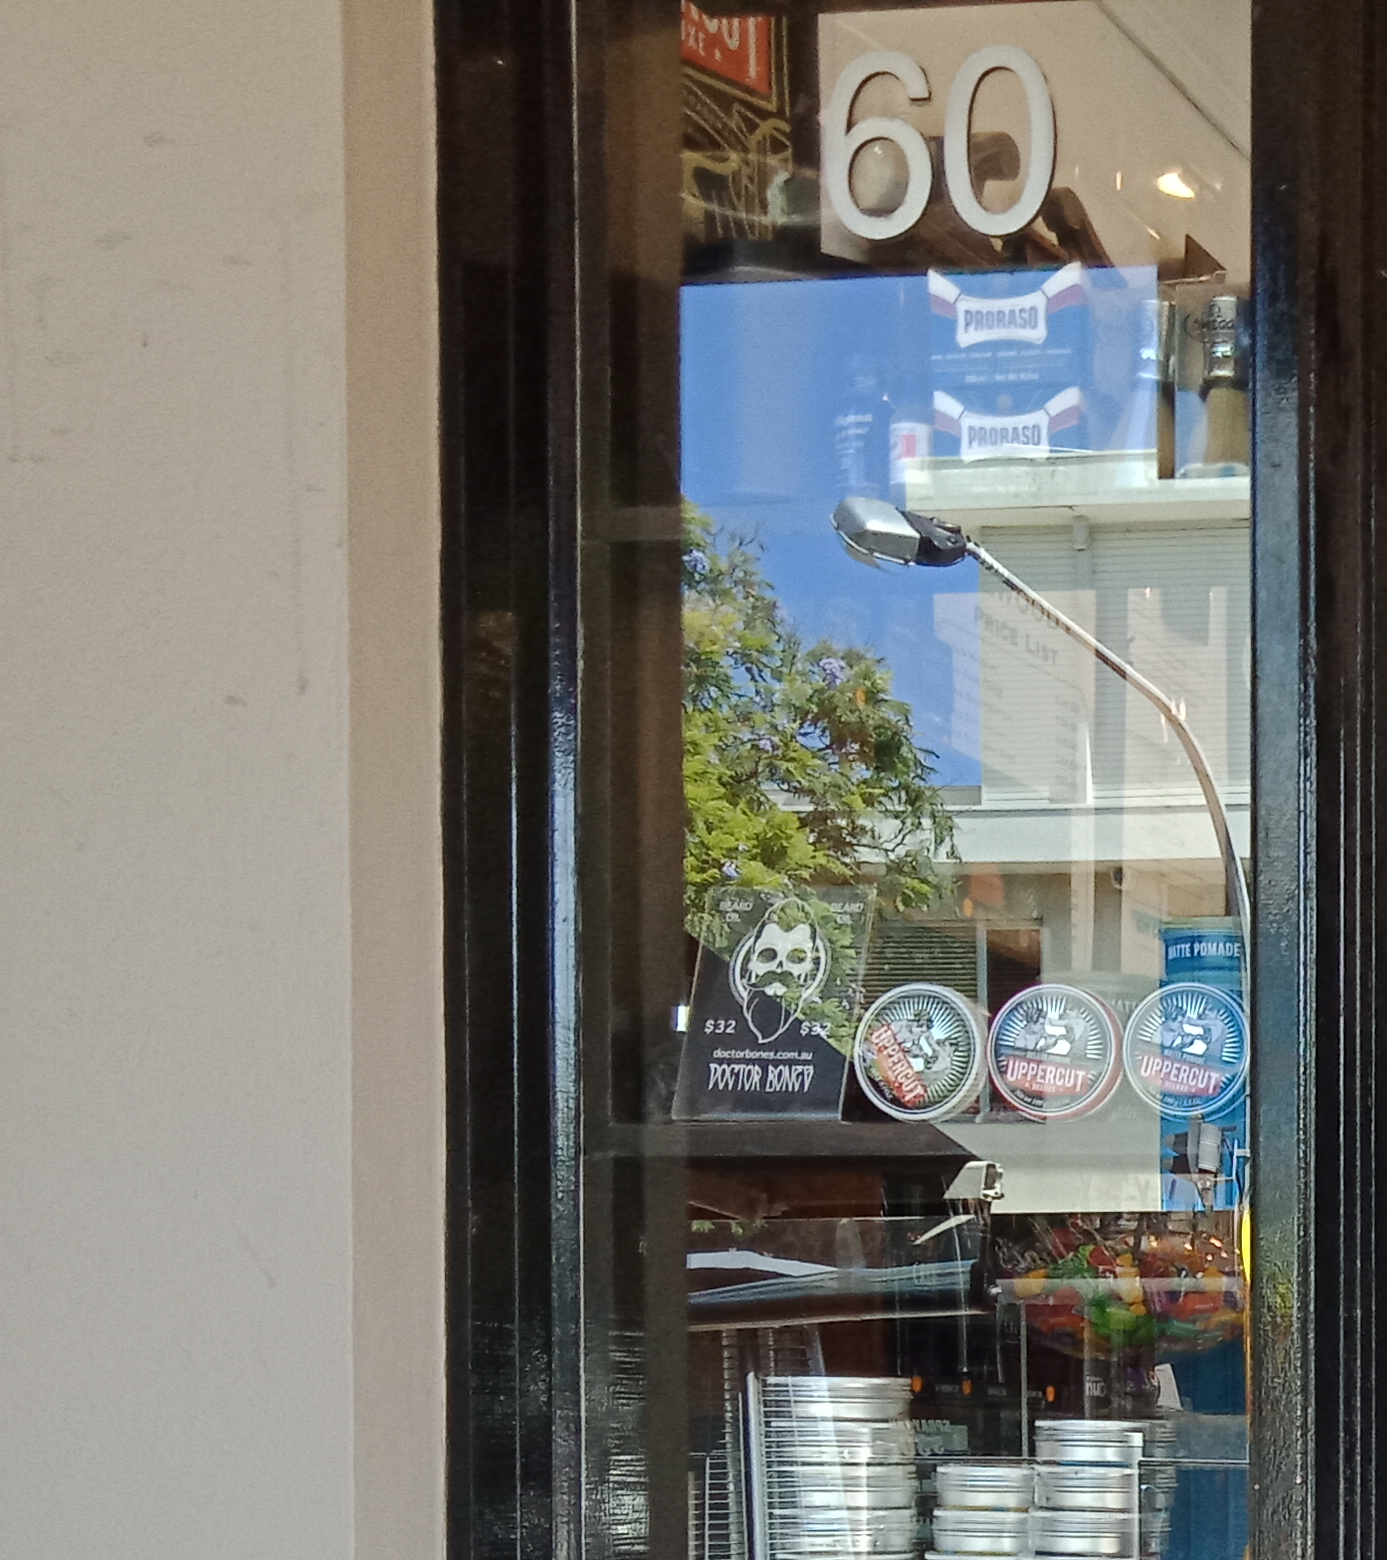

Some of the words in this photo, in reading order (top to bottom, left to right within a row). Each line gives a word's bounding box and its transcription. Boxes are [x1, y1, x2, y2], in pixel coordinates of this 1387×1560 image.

[824, 45, 1056, 240] 60
[964, 305, 1039, 334] PRORASO
[968, 424, 1041, 447] PRORASO
[1193, 941, 1241, 957] POMADE
[704, 1019, 737, 1035] $32
[713, 1048, 814, 1060] doctorbones.com.au
[870, 1024, 925, 1103] UPPERCUT
[708, 1063, 763, 1091] DOCTOR
[1007, 1059, 1087, 1092] UPPERCUT
[1140, 1057, 1220, 1094] UPPERCUT
